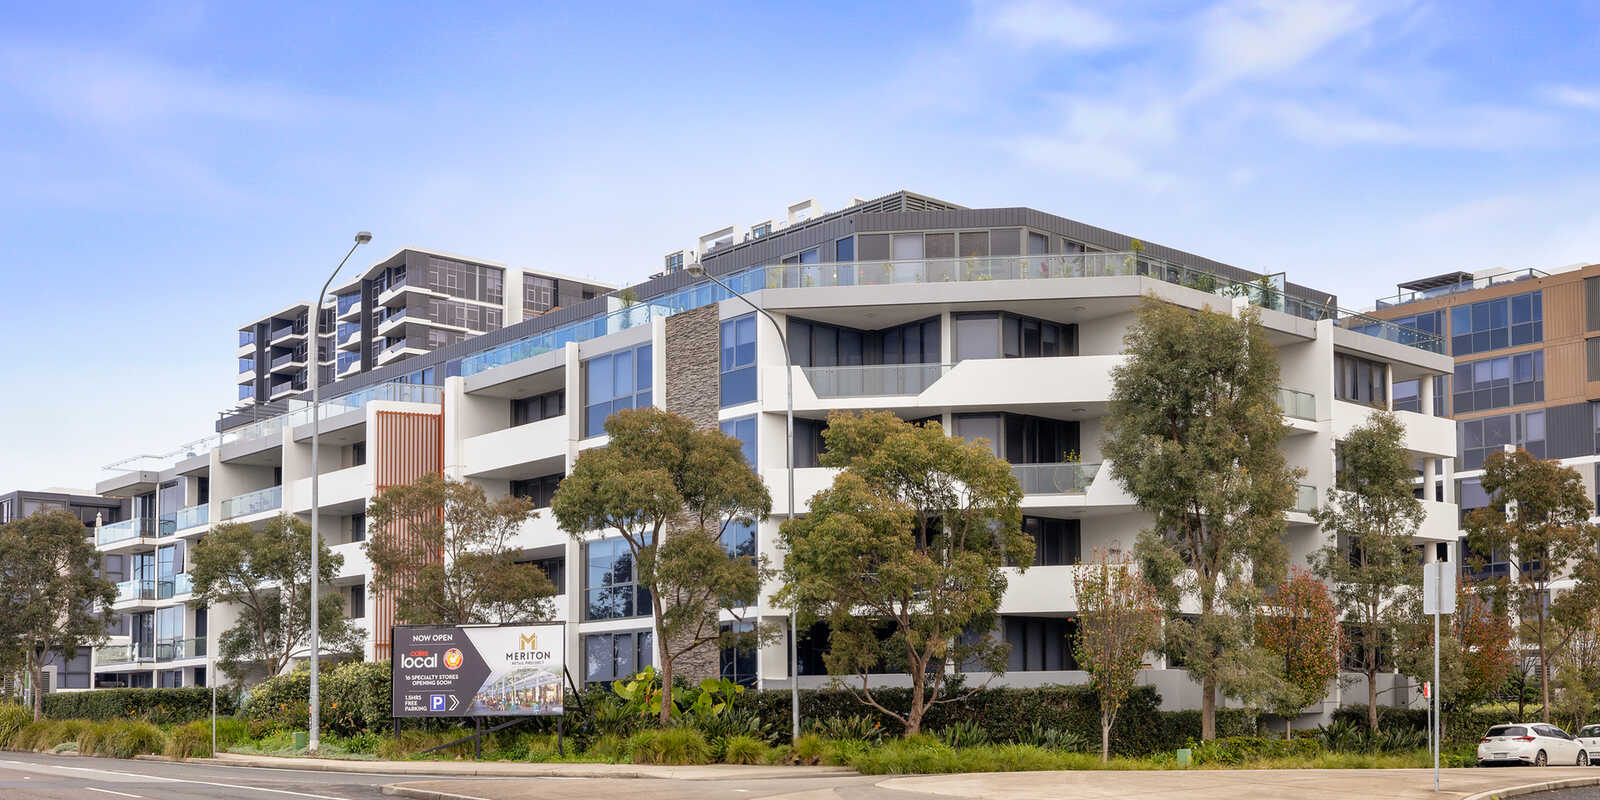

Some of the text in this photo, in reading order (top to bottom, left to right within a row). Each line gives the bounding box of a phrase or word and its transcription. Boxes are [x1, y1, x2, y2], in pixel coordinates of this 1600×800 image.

[401, 653, 438, 668] local
[505, 651, 551, 661] MERITON
[433, 696, 443, 710] P
